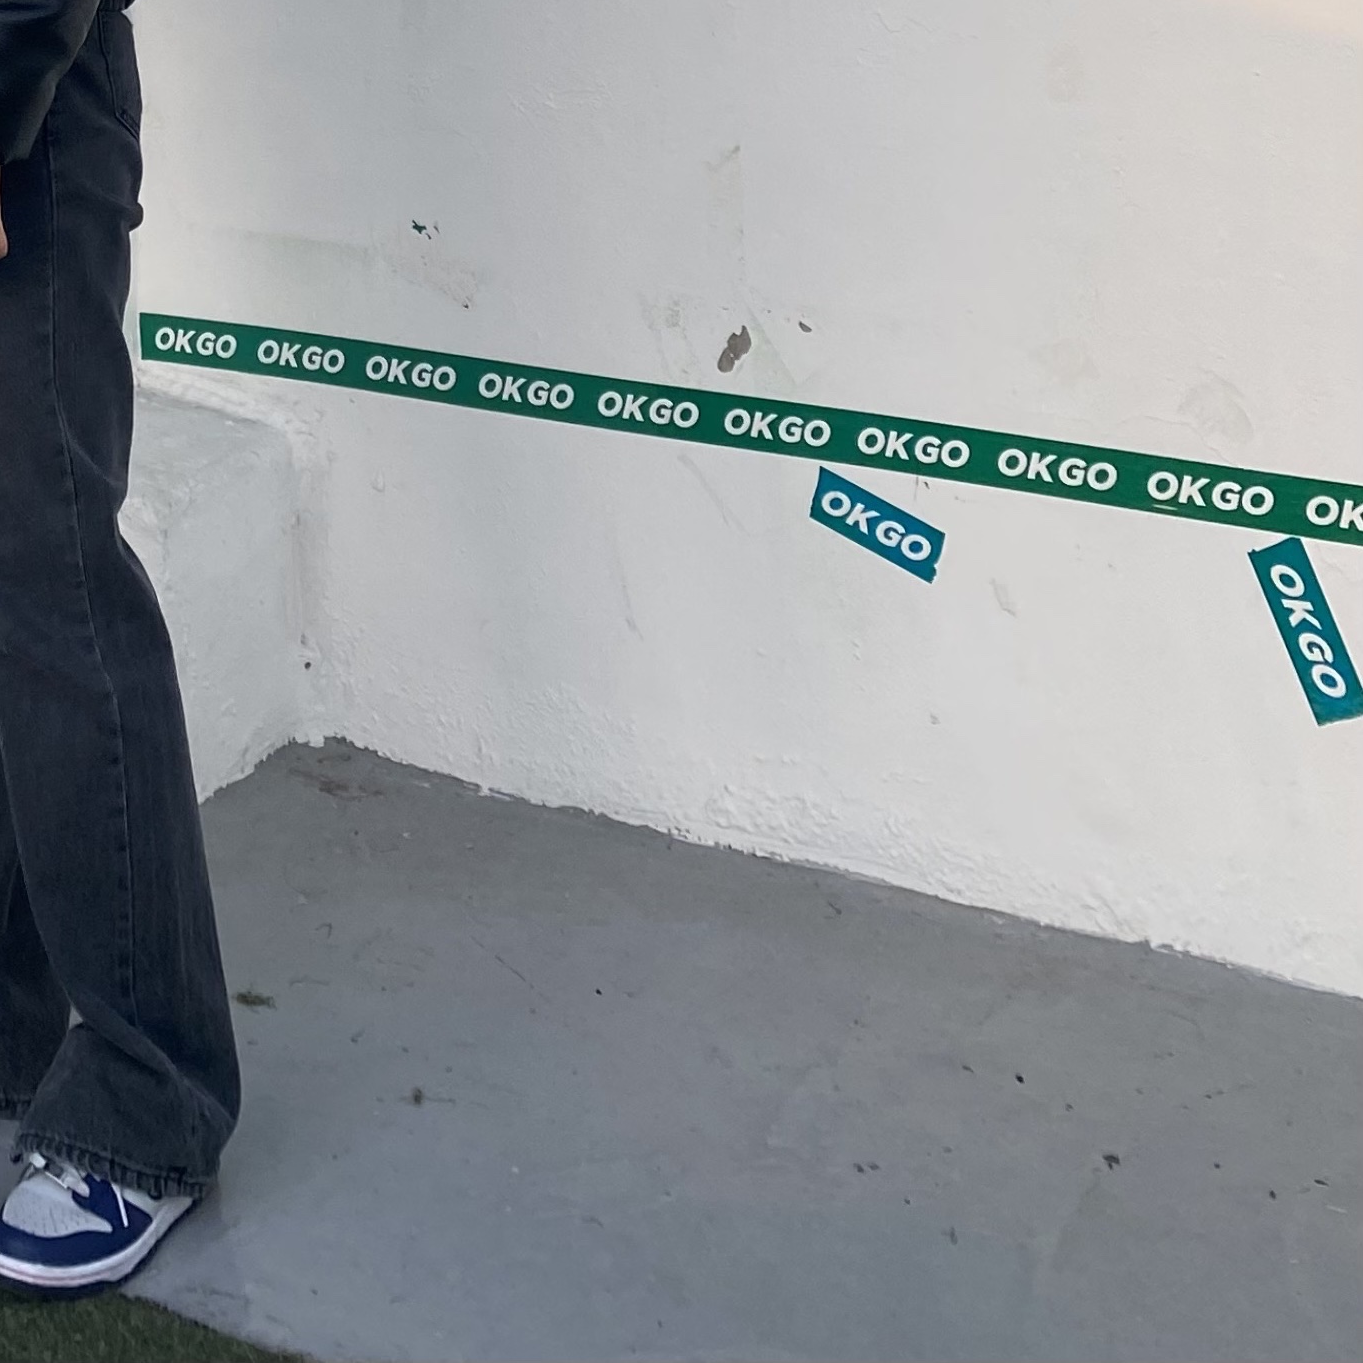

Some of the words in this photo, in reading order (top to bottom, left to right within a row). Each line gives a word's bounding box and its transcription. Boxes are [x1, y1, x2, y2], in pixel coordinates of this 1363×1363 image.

[155, 325, 237, 359] OKGO
[256, 339, 345, 374] OKGO
[366, 355, 456, 391] OKGO
[478, 372, 575, 410] OKGO
[597, 390, 699, 429] OKGO
[724, 407, 831, 447] OKGO
[856, 426, 970, 468] OKGO
[997, 447, 1118, 491] OKGO
[1147, 470, 1275, 517] OKGO
[821, 489, 932, 563] OKGO
[1270, 564, 1347, 699] OKGO
